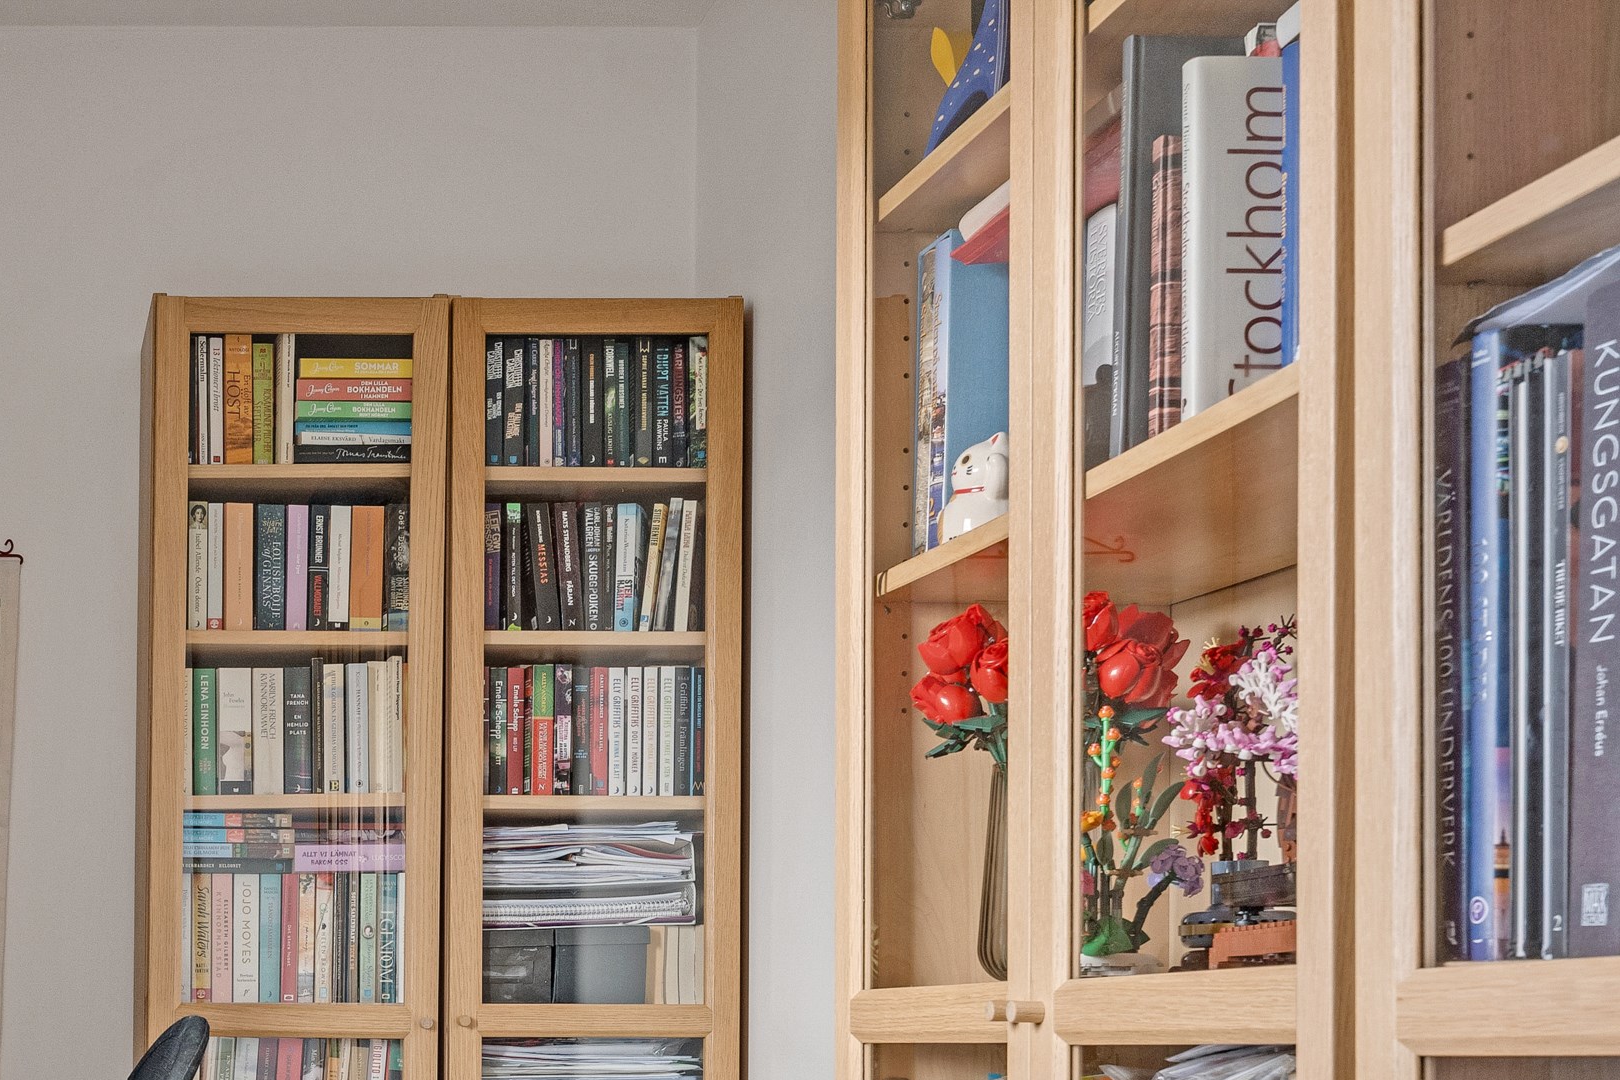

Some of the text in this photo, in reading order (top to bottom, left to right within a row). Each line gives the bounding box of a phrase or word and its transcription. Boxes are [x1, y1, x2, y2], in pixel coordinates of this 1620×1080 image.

[1226, 86, 1284, 398] tockholm
[199, 341, 208, 382] Södermalm
[213, 347, 221, 356] 13
[354, 362, 400, 371] SOMMAR
[487, 351, 495, 380] CARLSSON
[494, 342, 503, 379] CHRISTOFFER
[513, 349, 523, 387] CHRISTOFFER
[605, 347, 615, 378] CORNWELL
[656, 354, 669, 381] DJUPT
[212, 357, 221, 390] lektioner
[346, 385, 403, 393] BOKHANDELN
[506, 358, 515, 389] CARLSSON
[212, 394, 221, 412] brott
[226, 370, 243, 419] HÖST
[242, 374, 252, 416] En doft av
[656, 384, 669, 417] VATTEN
[252, 401, 262, 442] SEPTEMBER
[262, 388, 272, 454] ROSAMUNDE PILCHER
[1588, 341, 1620, 643] KUNGSGATAN
[489, 511, 500, 532] LEIF
[562, 510, 570, 529] MATS
[585, 507, 594, 547] VALLGREN
[593, 507, 601, 547] CARL-JOHAN
[652, 508, 662, 524] STIEG
[314, 515, 324, 564] ERNST BRUNNER
[489, 532, 500, 549] GW
[562, 529, 572, 572] STRANDBERG
[1435, 467, 1459, 626] VÄRLDENS
[271, 541, 282, 582] LOUISE
[262, 559, 273, 607] GENNÄS
[395, 576, 403, 610] OM FALLET
[588, 554, 599, 621] SKUGGPOJKEN
[624, 579, 633, 599] STEN
[1555, 558, 1566, 647] TREDJE RIKET
[200, 674, 209, 750] LENA EINHORN
[260, 673, 268, 739] KVINNORUMMET
[1592, 664, 1609, 756] Johan Erséus
[677, 682, 688, 772] Griffiths Främlingen
[301, 850, 319, 858] ALLT
[329, 850, 356, 858] LÄMNAT
[310, 858, 334, 866] BAKOM
[196, 884, 210, 958] Sarah Waters
[241, 881, 252, 965] JOJO MOYES
[1552, 914, 1563, 931] 2
[371, 1045, 383, 1074] GIOLITO
